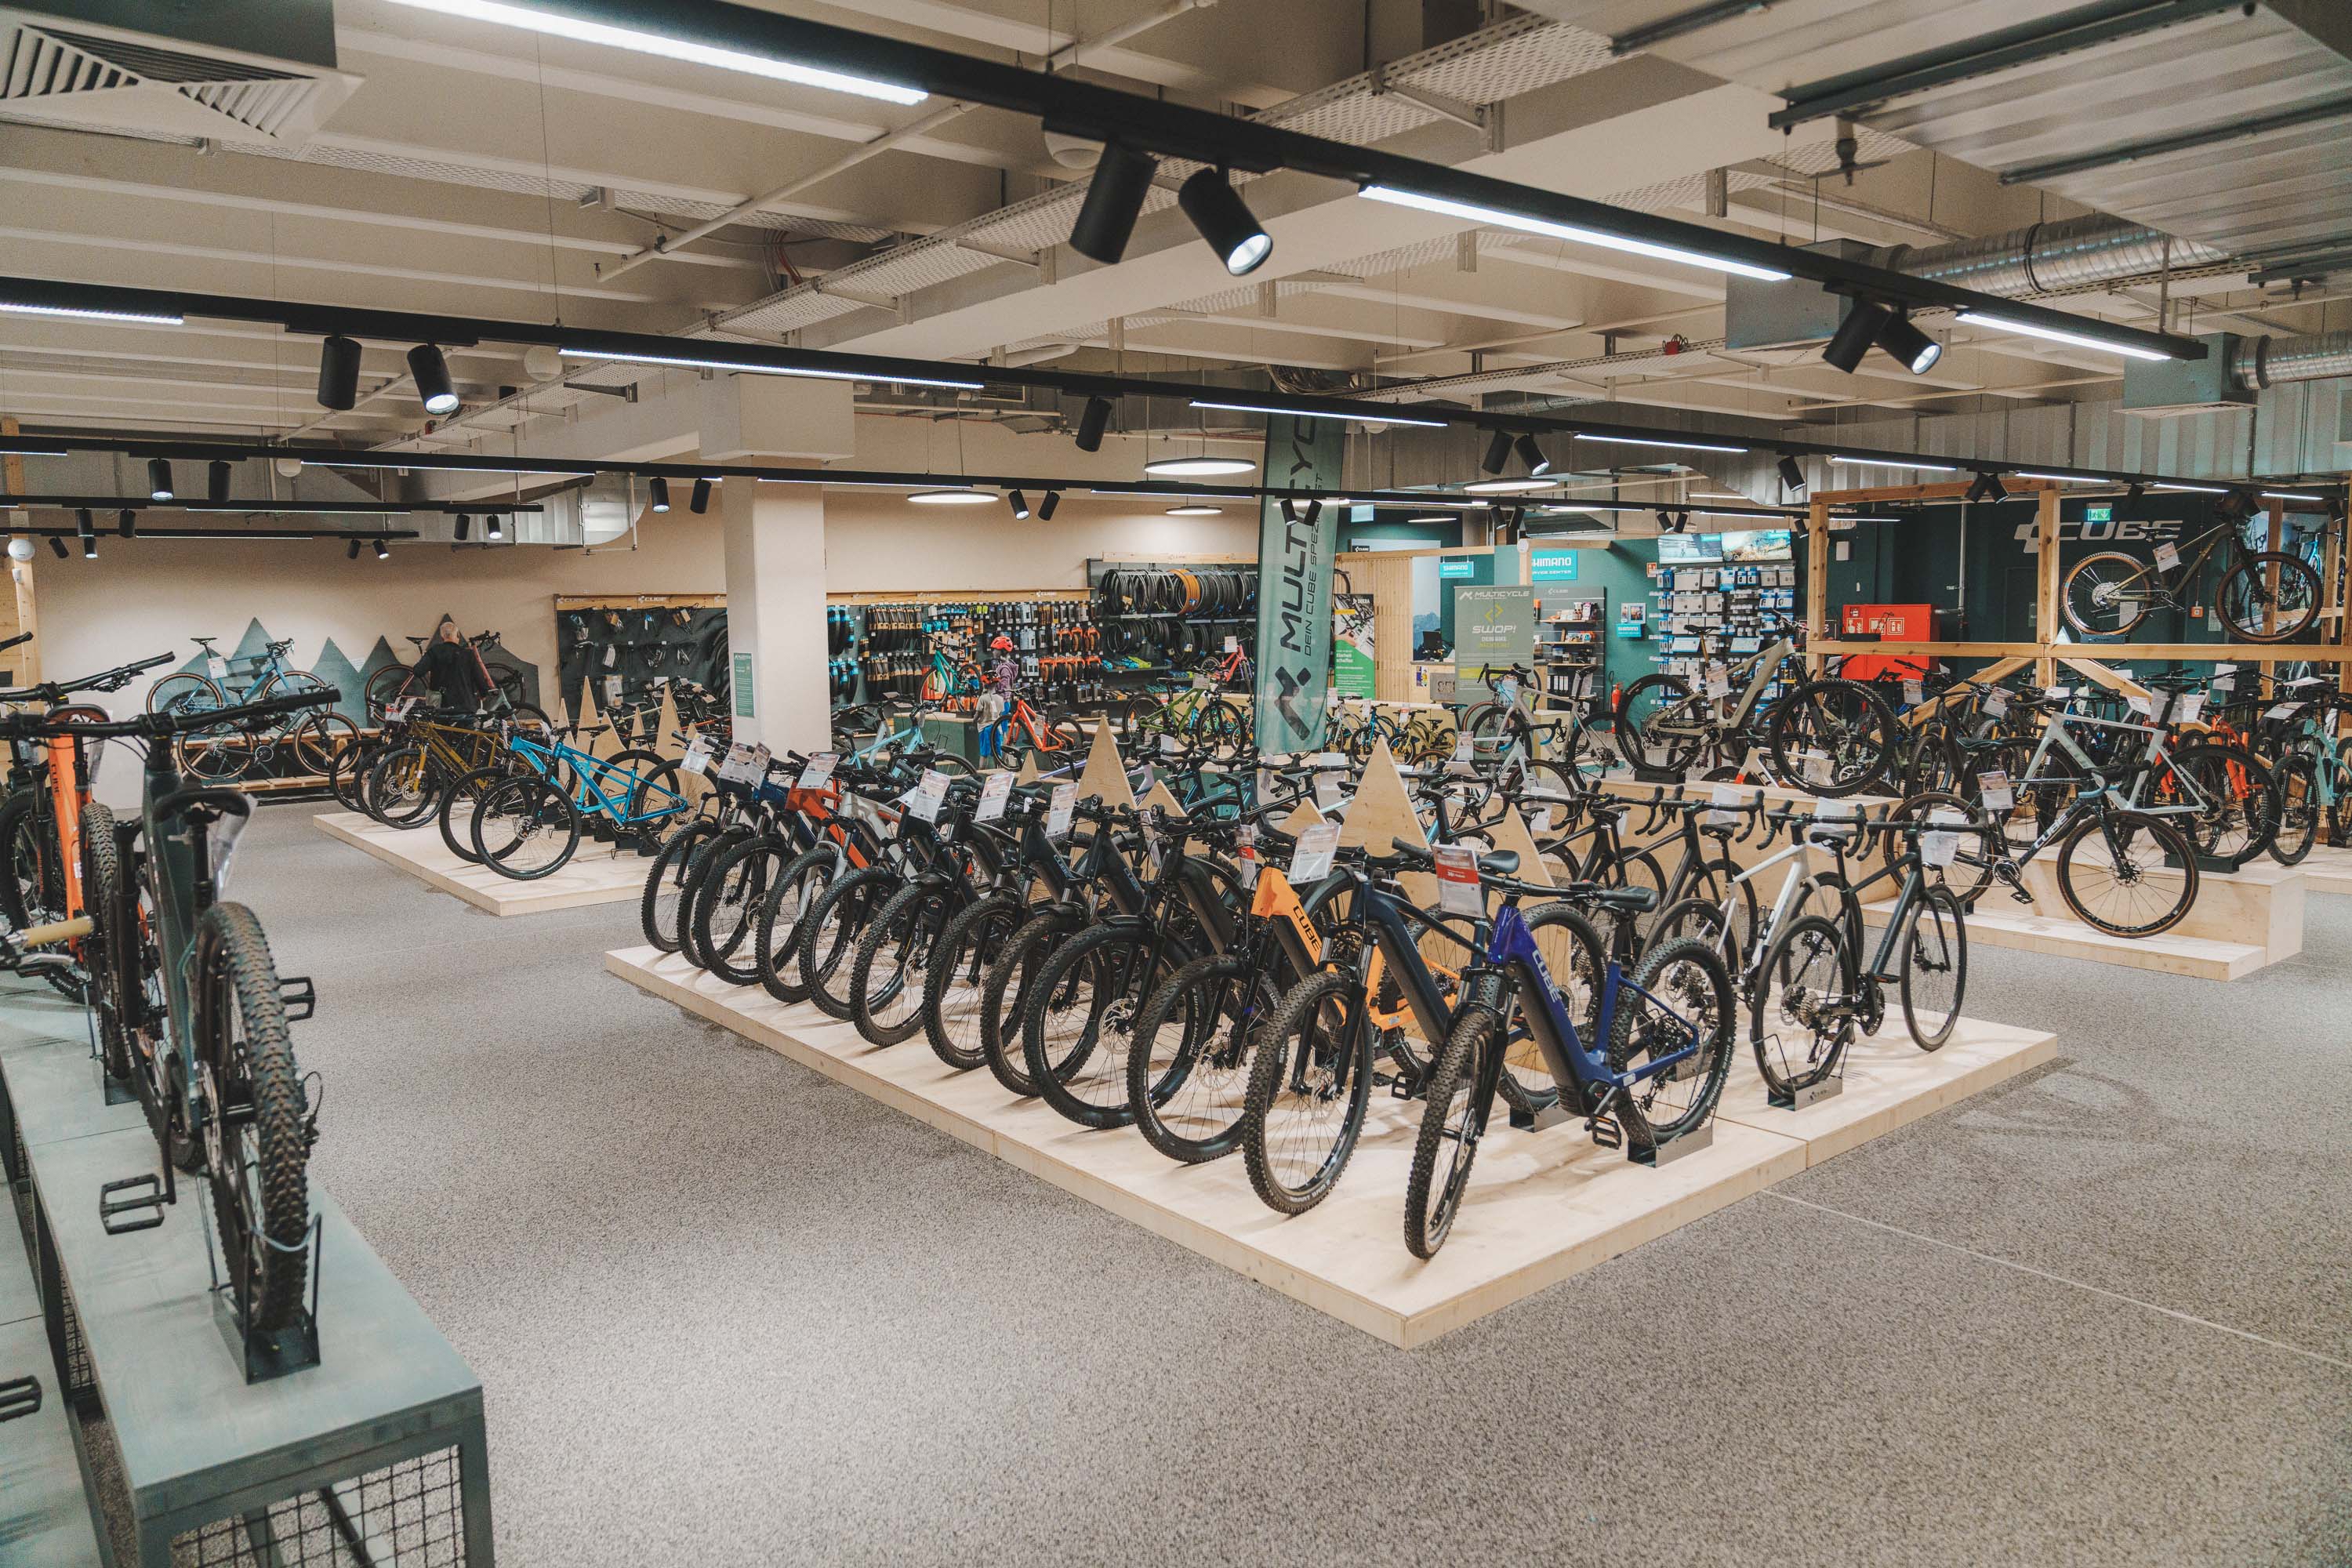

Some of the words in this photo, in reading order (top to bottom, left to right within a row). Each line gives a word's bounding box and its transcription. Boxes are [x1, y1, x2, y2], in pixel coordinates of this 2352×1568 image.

[1279, 414, 1316, 653] MULTYC
[1305, 571, 1317, 615] CUBE
[1472, 625, 1516, 633] SWOP!
[2033, 813, 2068, 849] CUBE
[1293, 905, 1322, 953] CUBE
[1532, 949, 1562, 1004] CUBE
